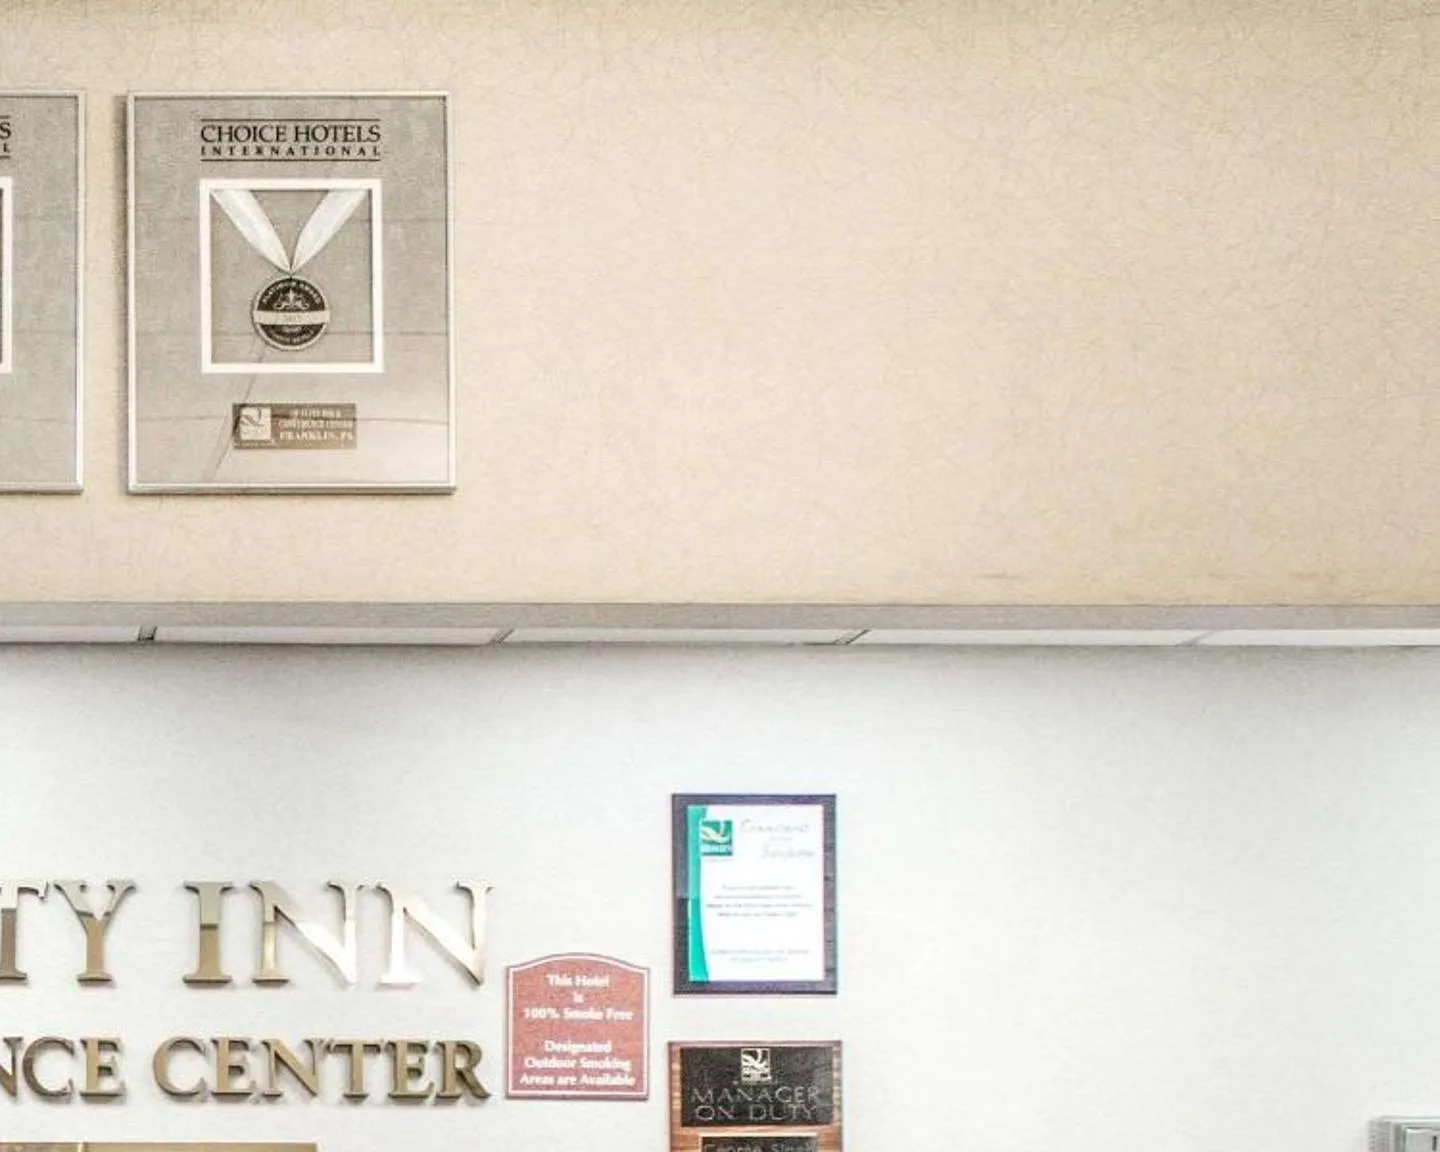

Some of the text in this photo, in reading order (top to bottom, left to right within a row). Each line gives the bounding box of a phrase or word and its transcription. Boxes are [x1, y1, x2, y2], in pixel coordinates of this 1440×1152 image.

[200, 124, 381, 143] CHOICE HOTELS
[200, 145, 381, 156] INTERNATIONAL
[183, 879, 494, 986] INN
[546, 974, 610, 987] This Hotel
[523, 1007, 634, 1021] 100% Smoke Free
[544, 1039, 613, 1056] Designated
[152, 1036, 492, 1101] CENTER
[524, 1056, 632, 1073] Outdoor Smoking
[519, 1073, 636, 1086] Areas are Available
[689, 1086, 820, 1103] MANAGER
[693, 1103, 818, 1121] ON DUTY
